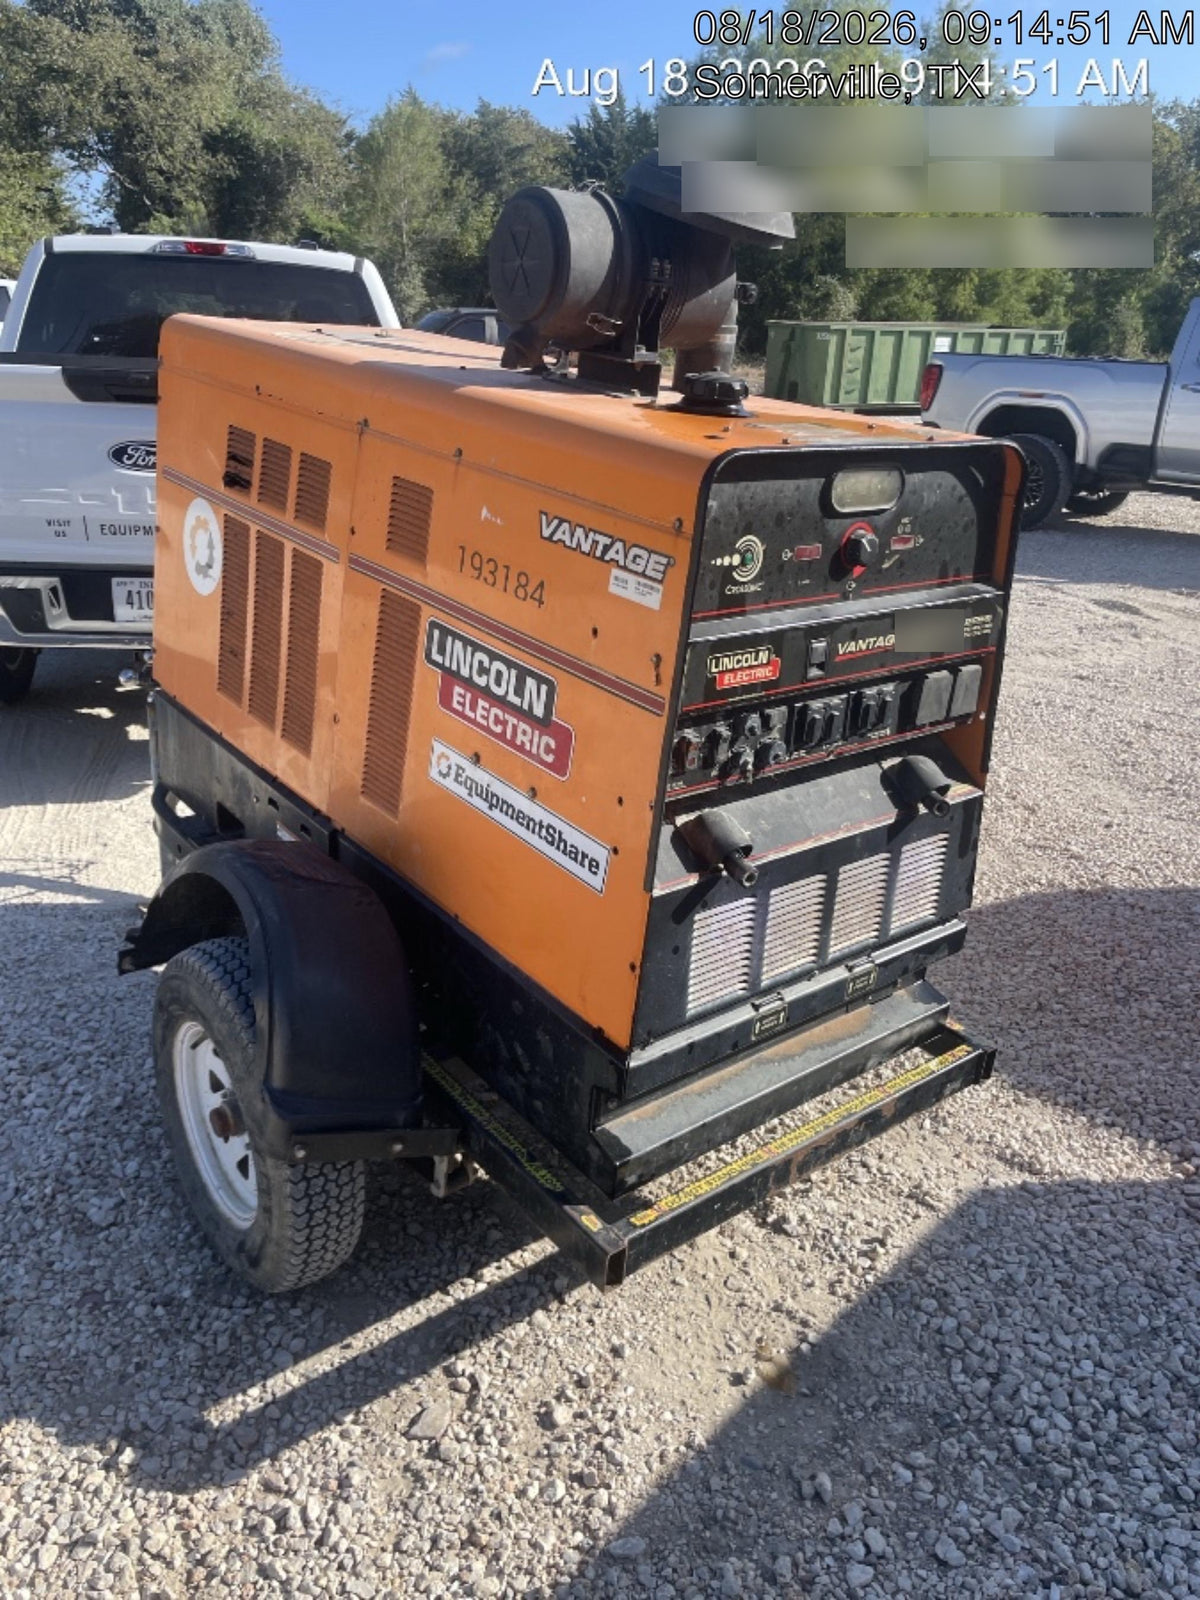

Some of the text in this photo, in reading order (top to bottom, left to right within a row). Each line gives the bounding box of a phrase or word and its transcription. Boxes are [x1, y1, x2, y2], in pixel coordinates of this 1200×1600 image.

[457, 544, 547, 609] 193184
[539, 511, 669, 581] VANTAGE
[430, 628, 549, 720] LINCOLN
[710, 649, 770, 673] LINCOLN
[723, 666, 774, 684] ELECTRIC
[451, 685, 557, 765] ELECTRIC
[452, 762, 601, 876] EquipmentShare
